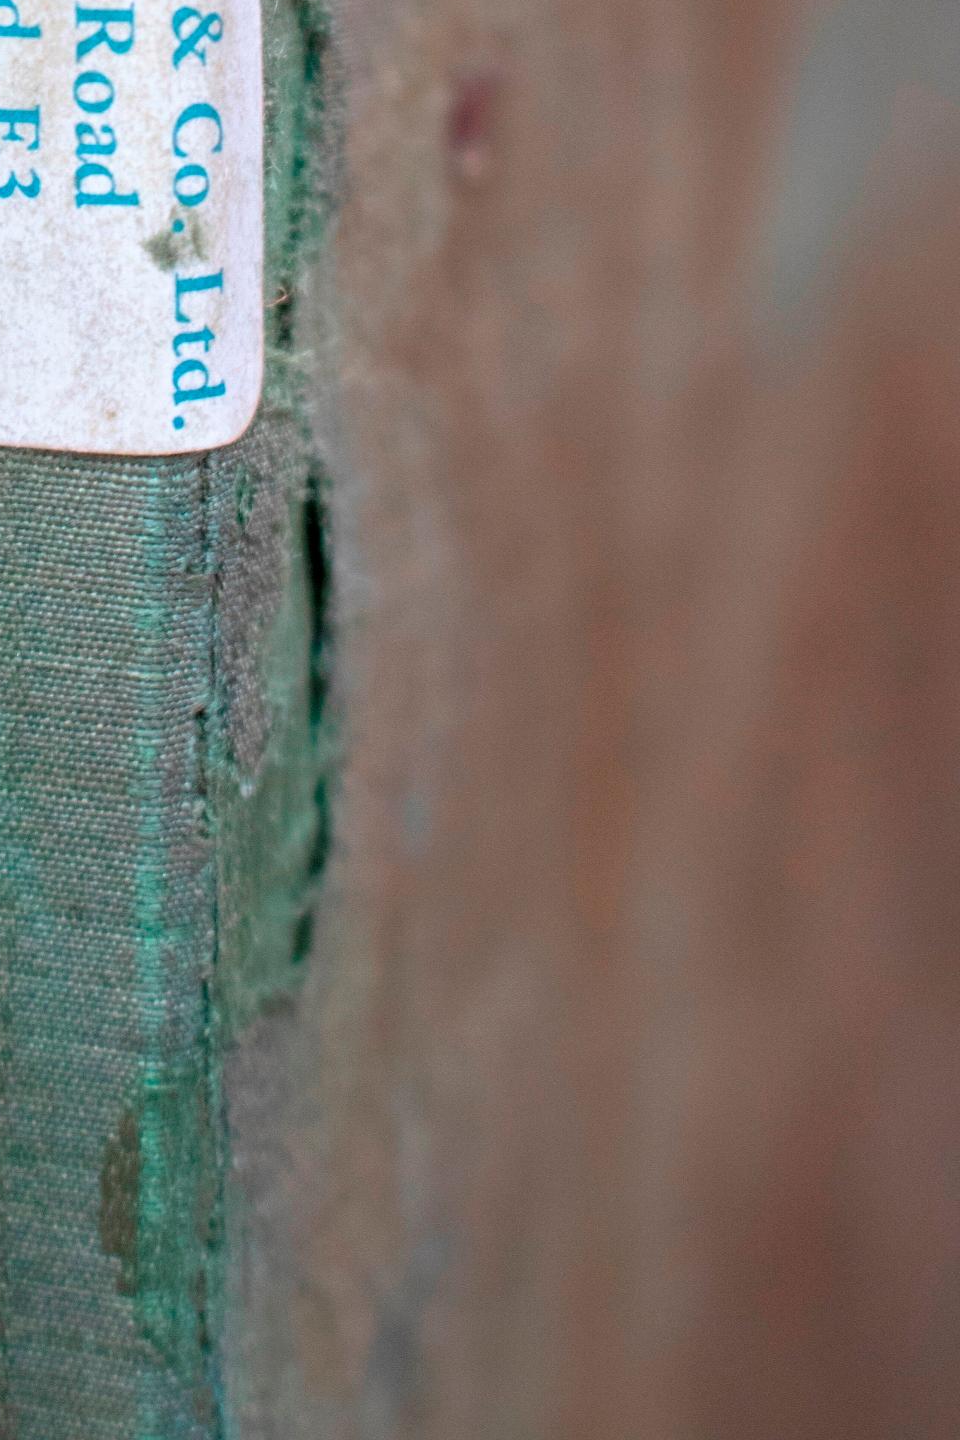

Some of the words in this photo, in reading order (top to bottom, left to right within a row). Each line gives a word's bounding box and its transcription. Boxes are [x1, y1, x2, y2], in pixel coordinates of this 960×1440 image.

[71, 1, 142, 210] Road
[171, 5, 224, 71] &
[171, 102, 224, 235] Co.
[171, 268, 227, 432] Ltd.
